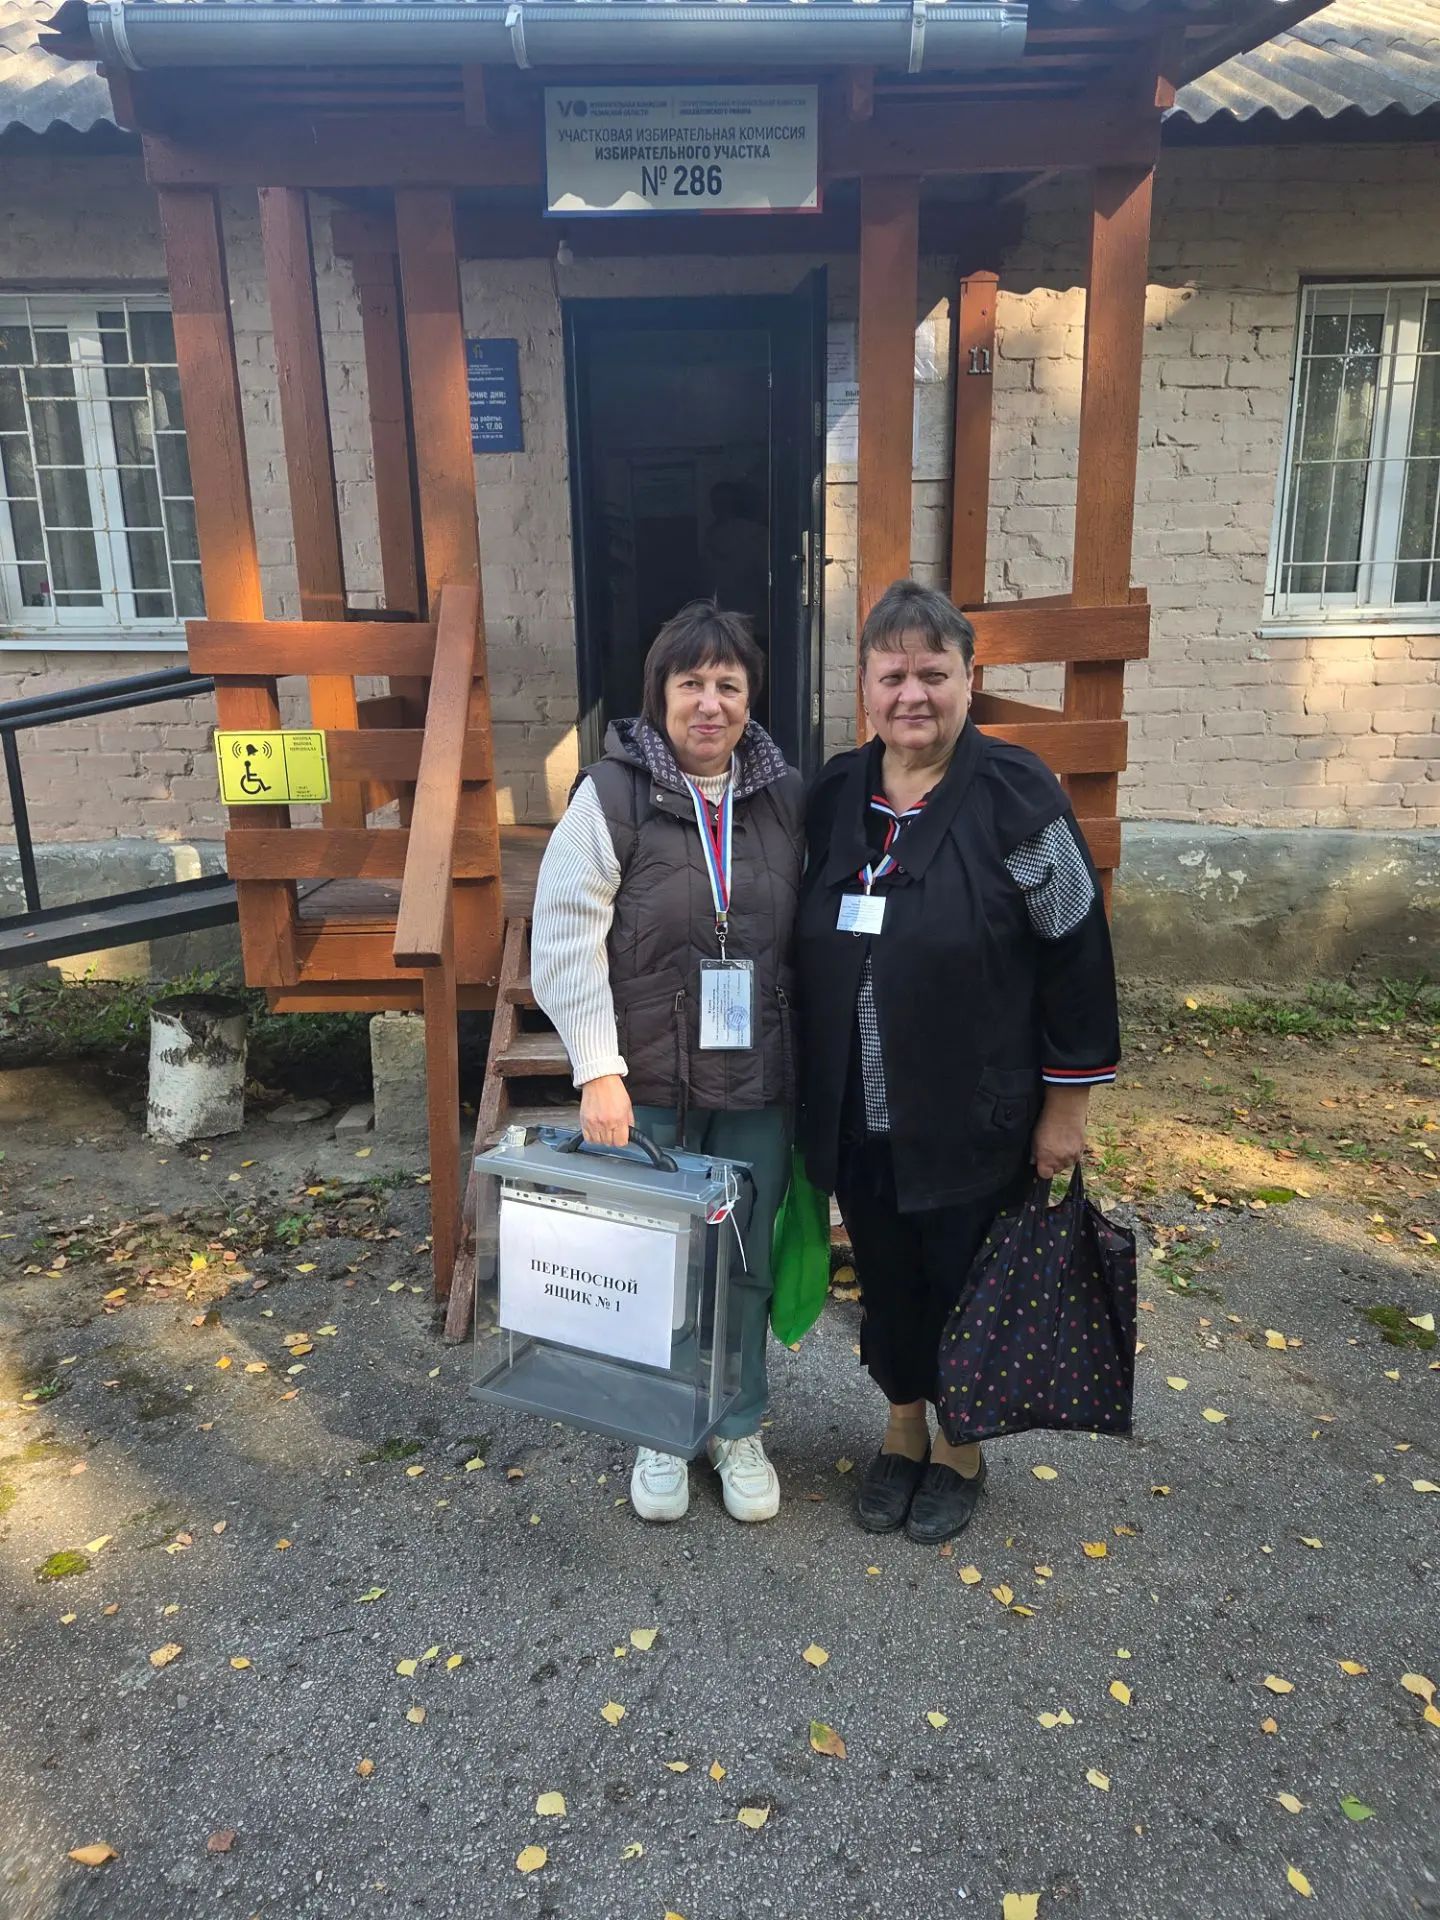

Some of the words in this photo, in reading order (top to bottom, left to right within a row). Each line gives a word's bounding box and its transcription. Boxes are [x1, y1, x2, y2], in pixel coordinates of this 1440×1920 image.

[558, 128, 632, 143] УЧАСТКОВАЯ
[636, 127, 736, 142] ИЗБИРАТЕЛЬНАЯ
[739, 126, 806, 141] КОМИССИЯ
[595, 145, 710, 161] ИЗБИРАТЕЛЬНОГО
[713, 144, 771, 160] УЧАСТКА
[641, 165, 667, 196] №
[673, 164, 722, 196] 286
[968, 346, 992, 376] 11
[531, 1259, 638, 1294] ПЕРЕНОСНОЙ
[544, 1283, 593, 1306] ЯЩИК
[595, 1295, 611, 1310] №
[615, 1300, 621, 1312] 1
